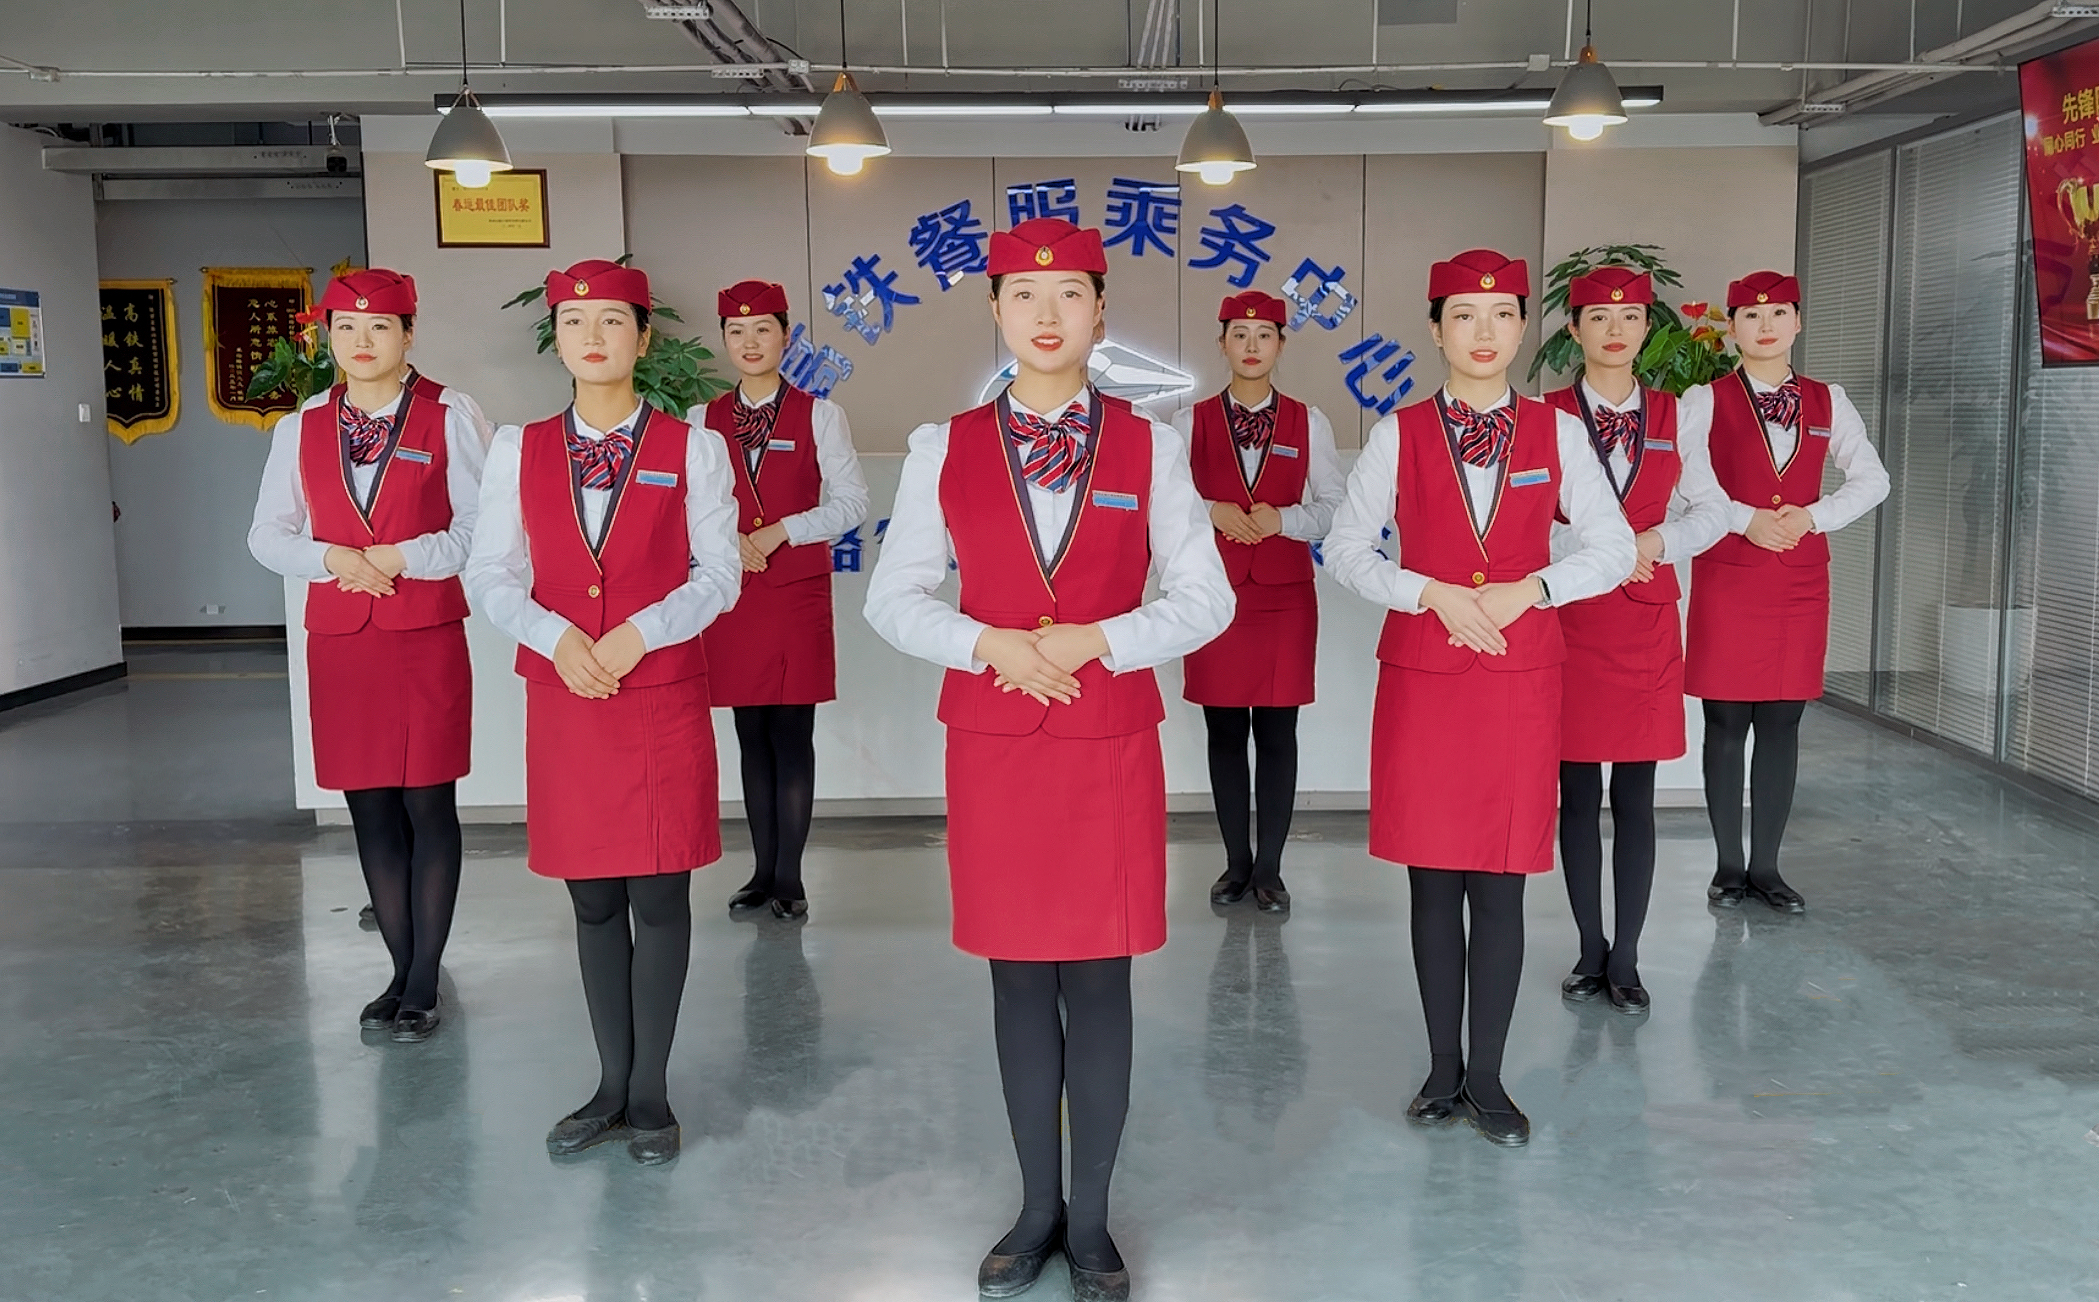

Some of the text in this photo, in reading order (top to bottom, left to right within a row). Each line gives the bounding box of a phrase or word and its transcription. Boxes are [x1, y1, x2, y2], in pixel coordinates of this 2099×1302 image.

[2062, 86, 2099, 124] 先锋
[452, 198, 530, 212] 春运最佳团队奖
[779, 177, 1416, 416] 高铁餐服乘务中心
